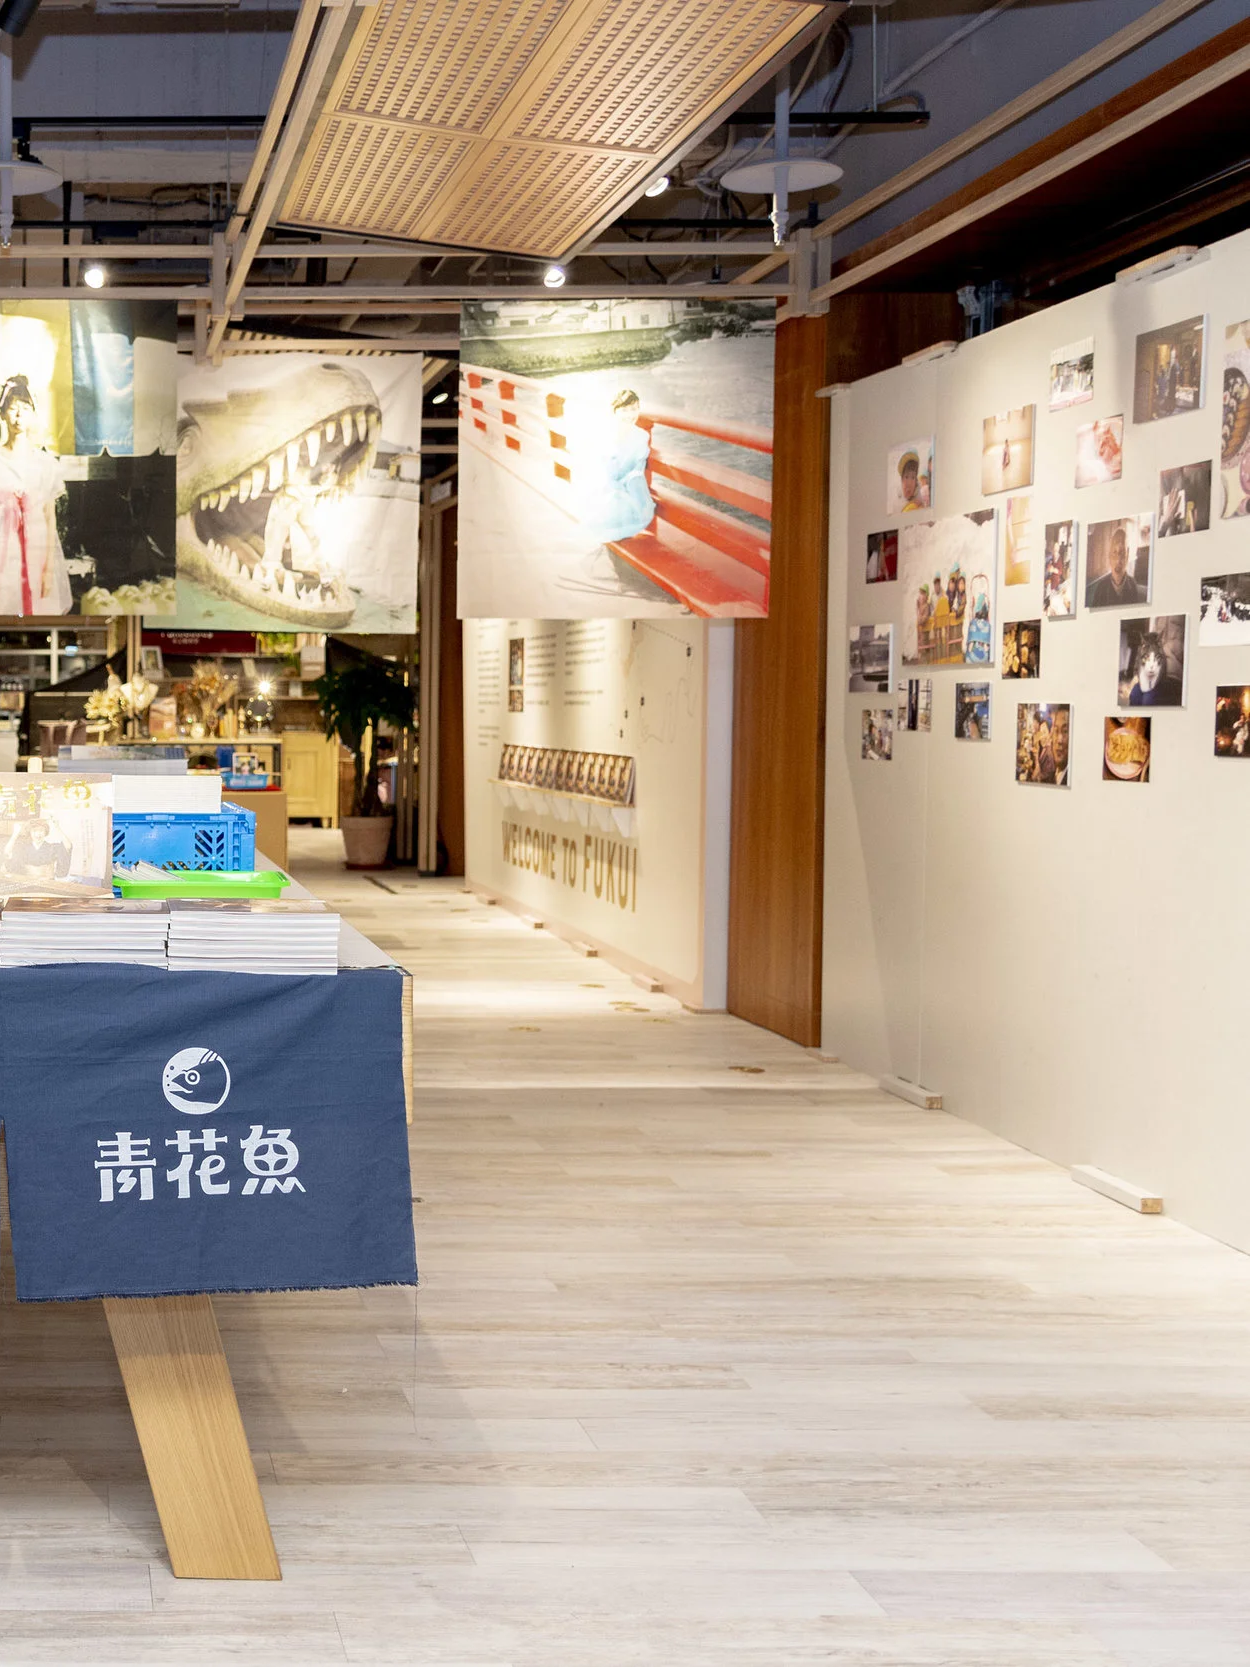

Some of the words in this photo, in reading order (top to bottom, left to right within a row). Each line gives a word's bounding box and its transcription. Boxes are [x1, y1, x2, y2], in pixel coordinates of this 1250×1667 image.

[502, 821, 557, 880] WELCOME
[562, 838, 577, 888] TO
[583, 834, 637, 913] FUKUI
[94, 1124, 307, 1202] 青花魚
